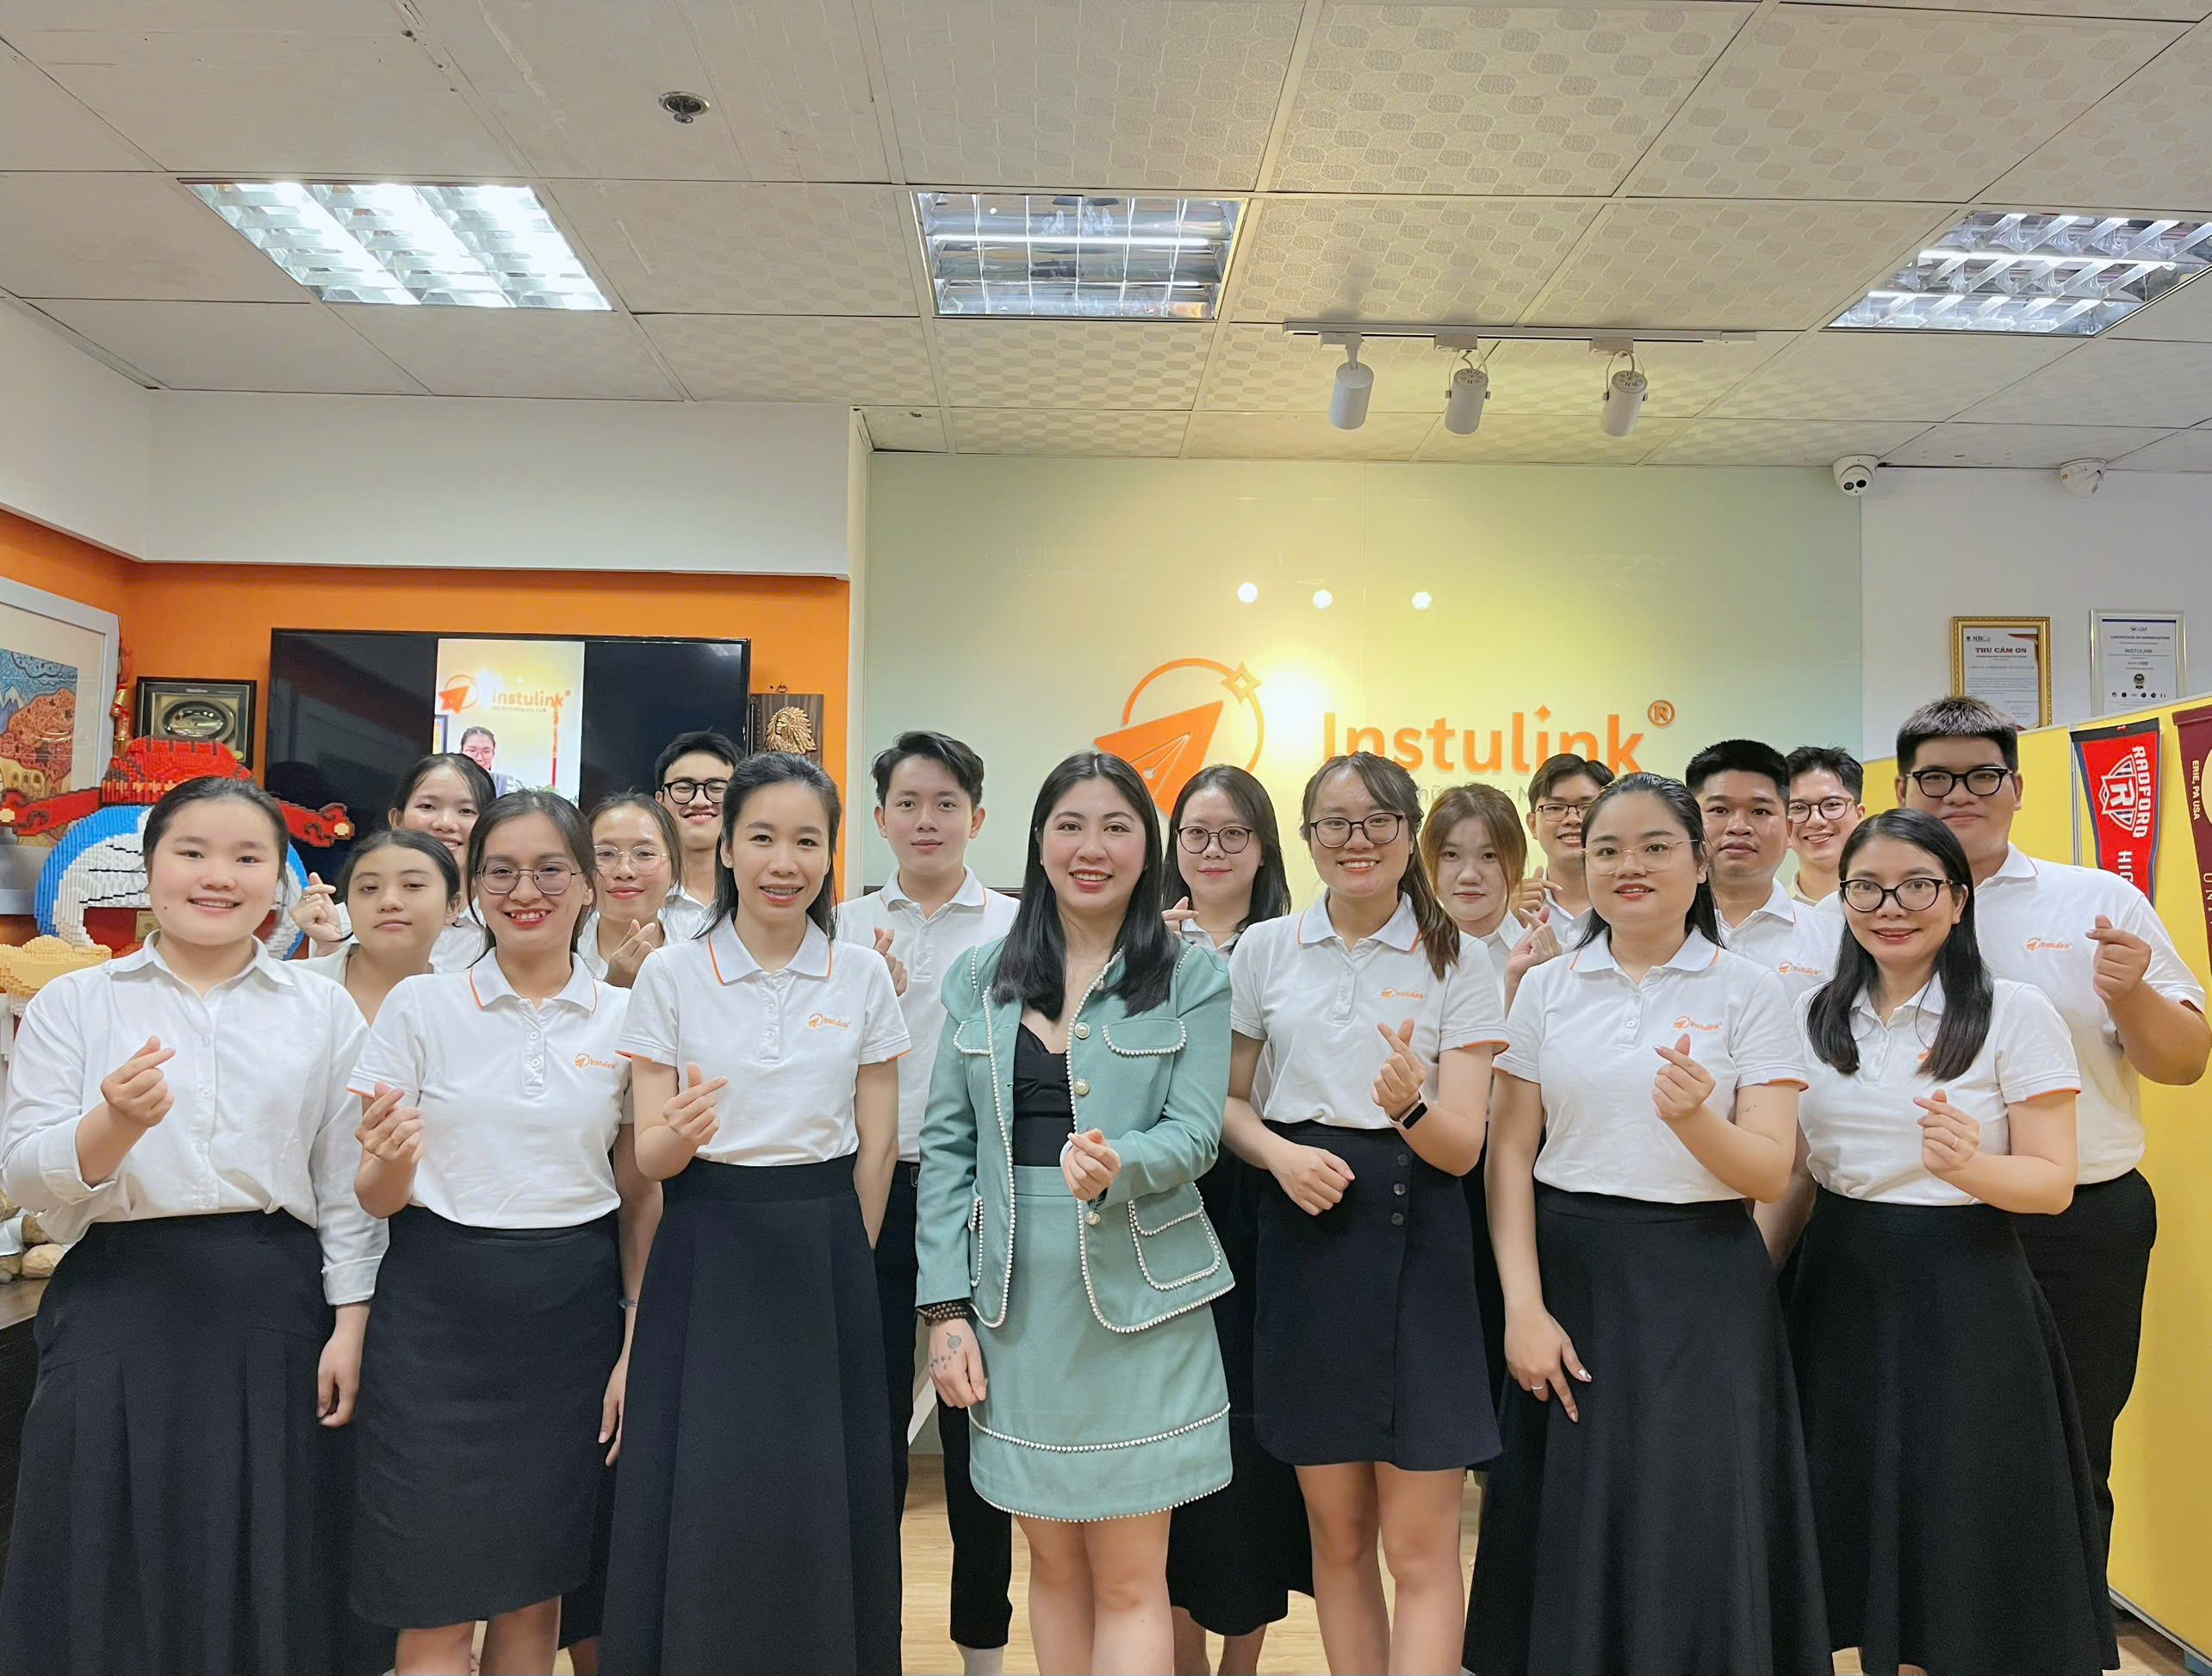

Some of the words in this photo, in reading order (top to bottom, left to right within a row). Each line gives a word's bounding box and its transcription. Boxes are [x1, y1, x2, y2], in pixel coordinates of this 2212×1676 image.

[1324, 705, 1644, 773] Instulink
[2132, 746, 2151, 838] RADFORD
[2192, 785, 2200, 799] PA
